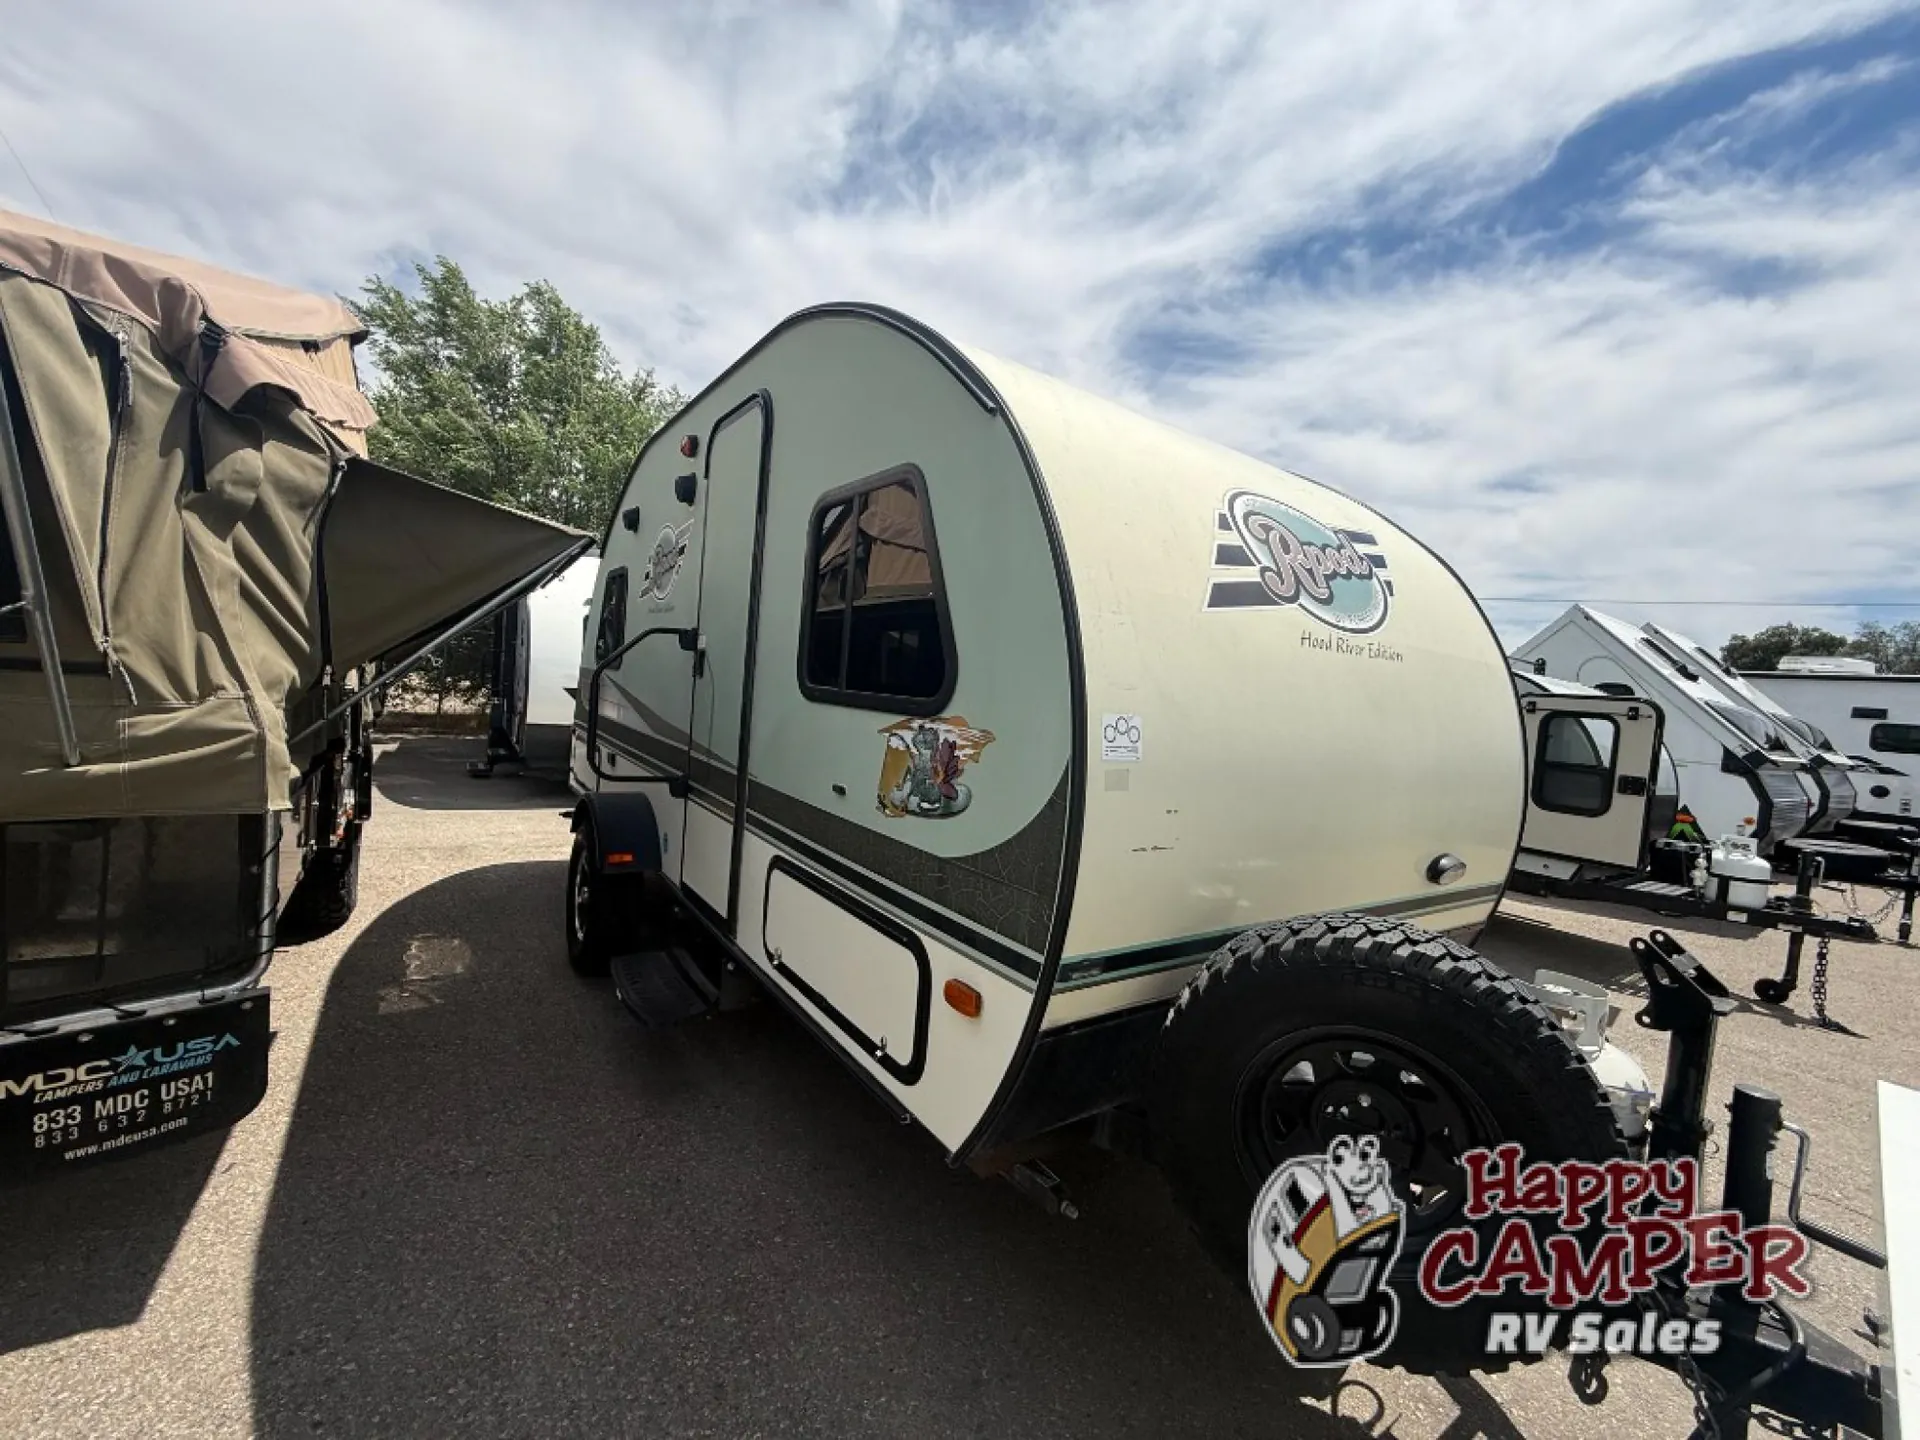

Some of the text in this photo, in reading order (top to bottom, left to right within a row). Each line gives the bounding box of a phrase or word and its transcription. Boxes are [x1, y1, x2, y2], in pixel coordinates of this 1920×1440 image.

[1300, 630, 1404, 662] Hood River Edition
[0, 1032, 240, 1099] MDC USA
[33, 1053, 213, 1104] CAMPERS AND CARAVANS
[33, 1071, 213, 1133] 833 MDC USA1
[63, 1116, 188, 1160] www.mdcusa.com
